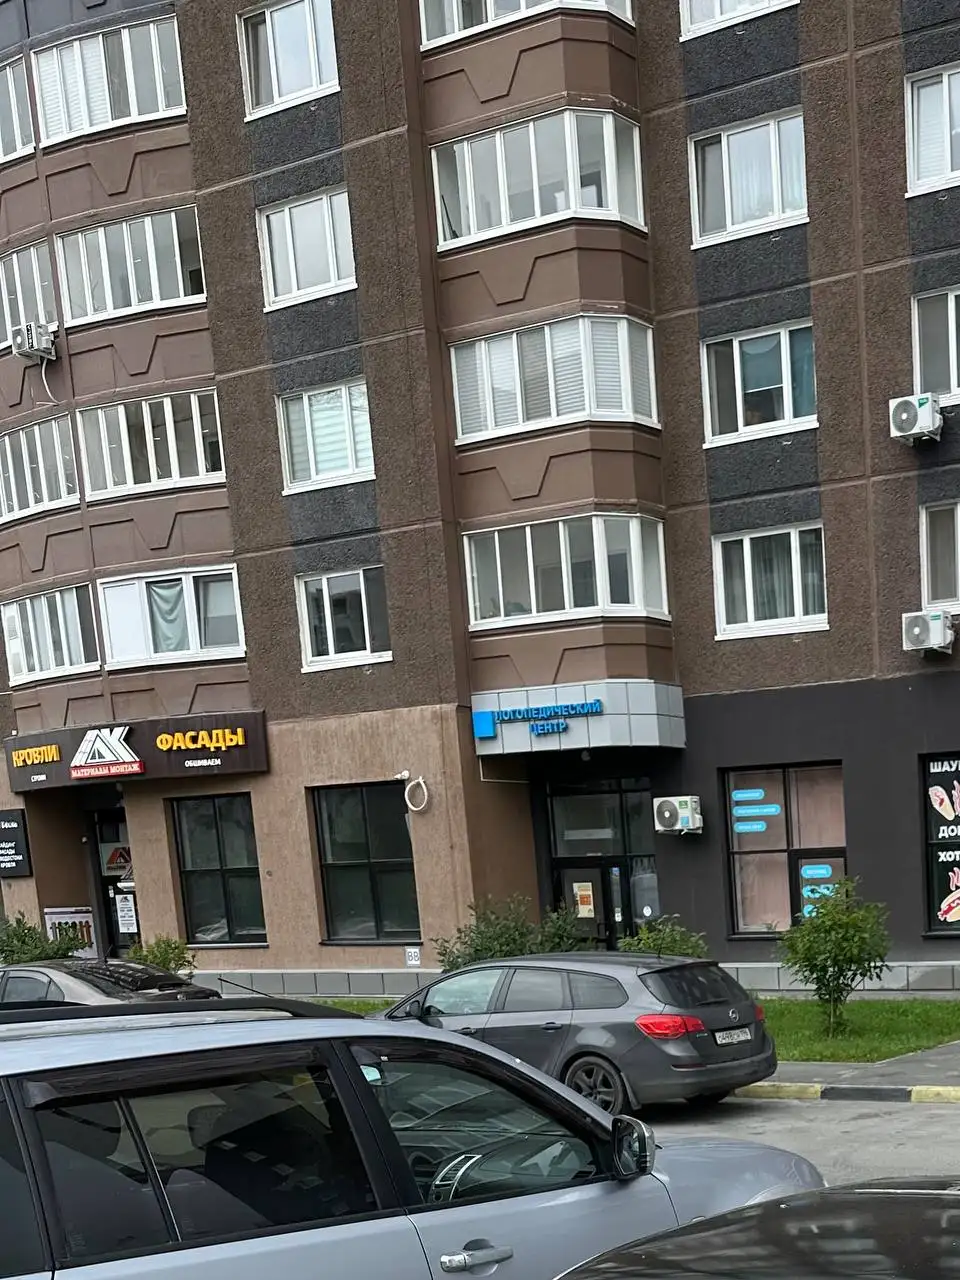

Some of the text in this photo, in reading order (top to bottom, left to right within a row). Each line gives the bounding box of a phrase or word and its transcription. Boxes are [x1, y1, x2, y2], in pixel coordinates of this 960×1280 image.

[493, 699, 603, 721] ЛОГОПЕДИЧЕСКИЙ
[530, 719, 568, 736] ЦЕНТР
[156, 727, 246, 752] ФАСАДЫ
[11, 744, 61, 768] КРОВЛИ
